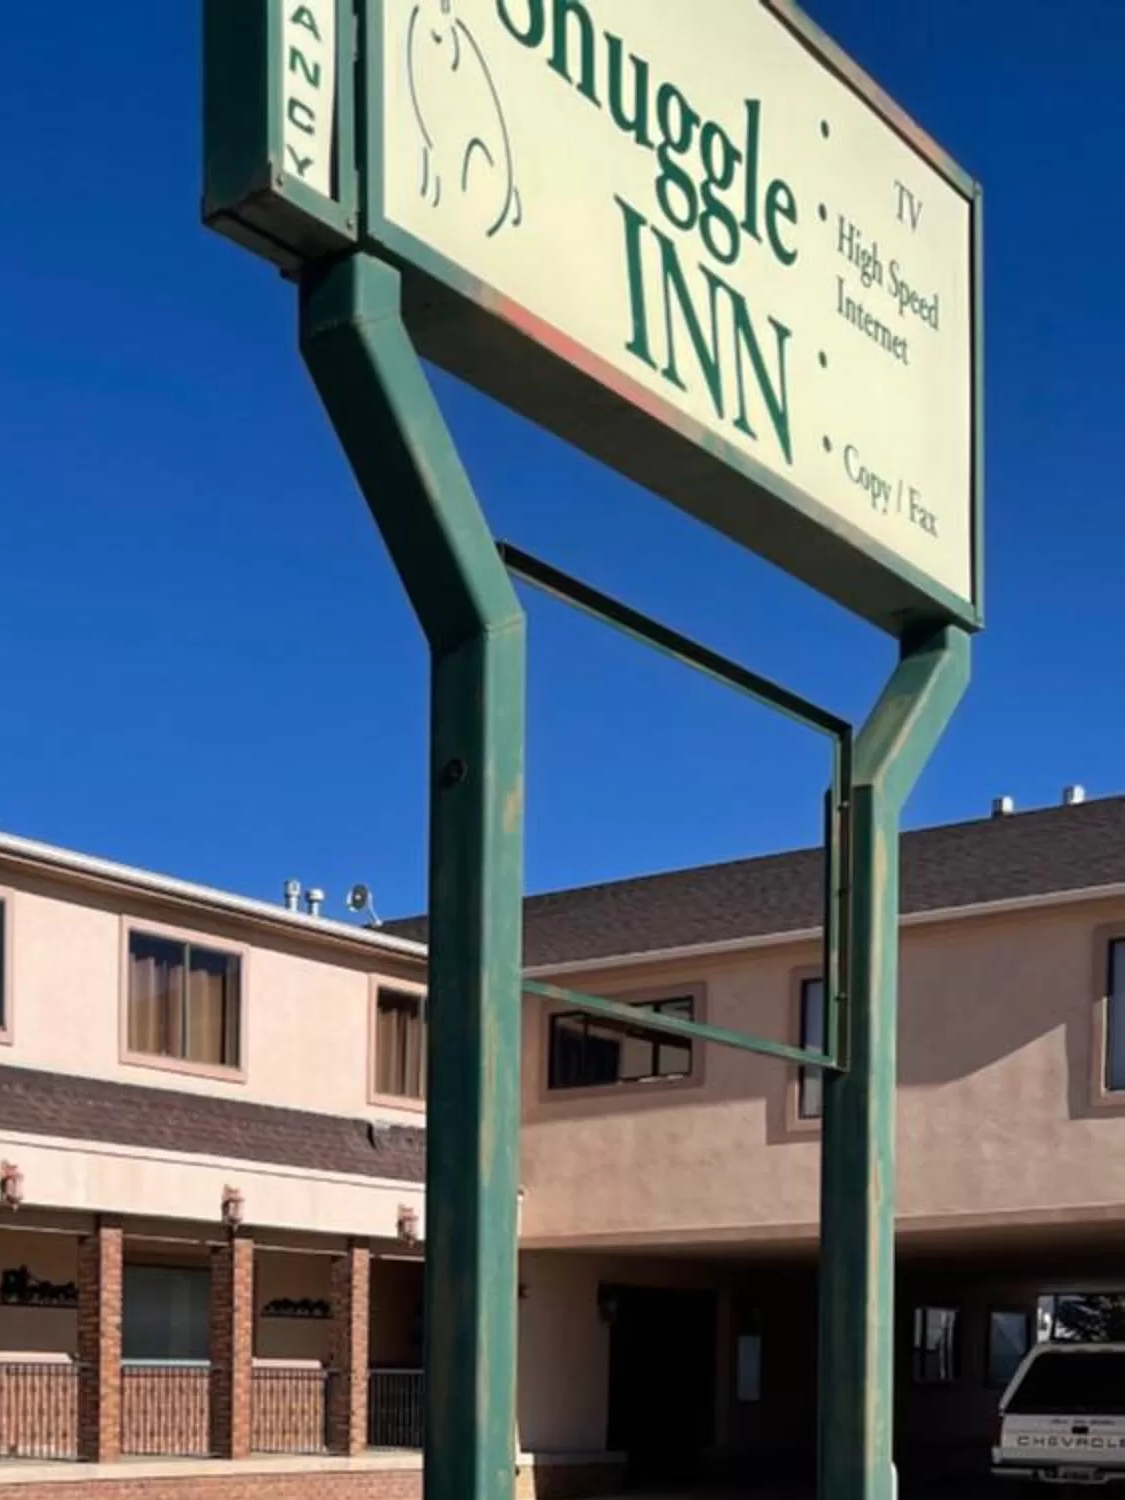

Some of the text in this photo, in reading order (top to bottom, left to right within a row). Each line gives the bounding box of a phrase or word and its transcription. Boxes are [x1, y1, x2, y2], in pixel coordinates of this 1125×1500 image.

[894, 179, 923, 232] TV
[837, 214, 940, 332] High Speed
[837, 274, 909, 366] Internet
[613, 194, 793, 465] INN
[843, 444, 892, 516] Copy
[908, 485, 940, 538] Fax
